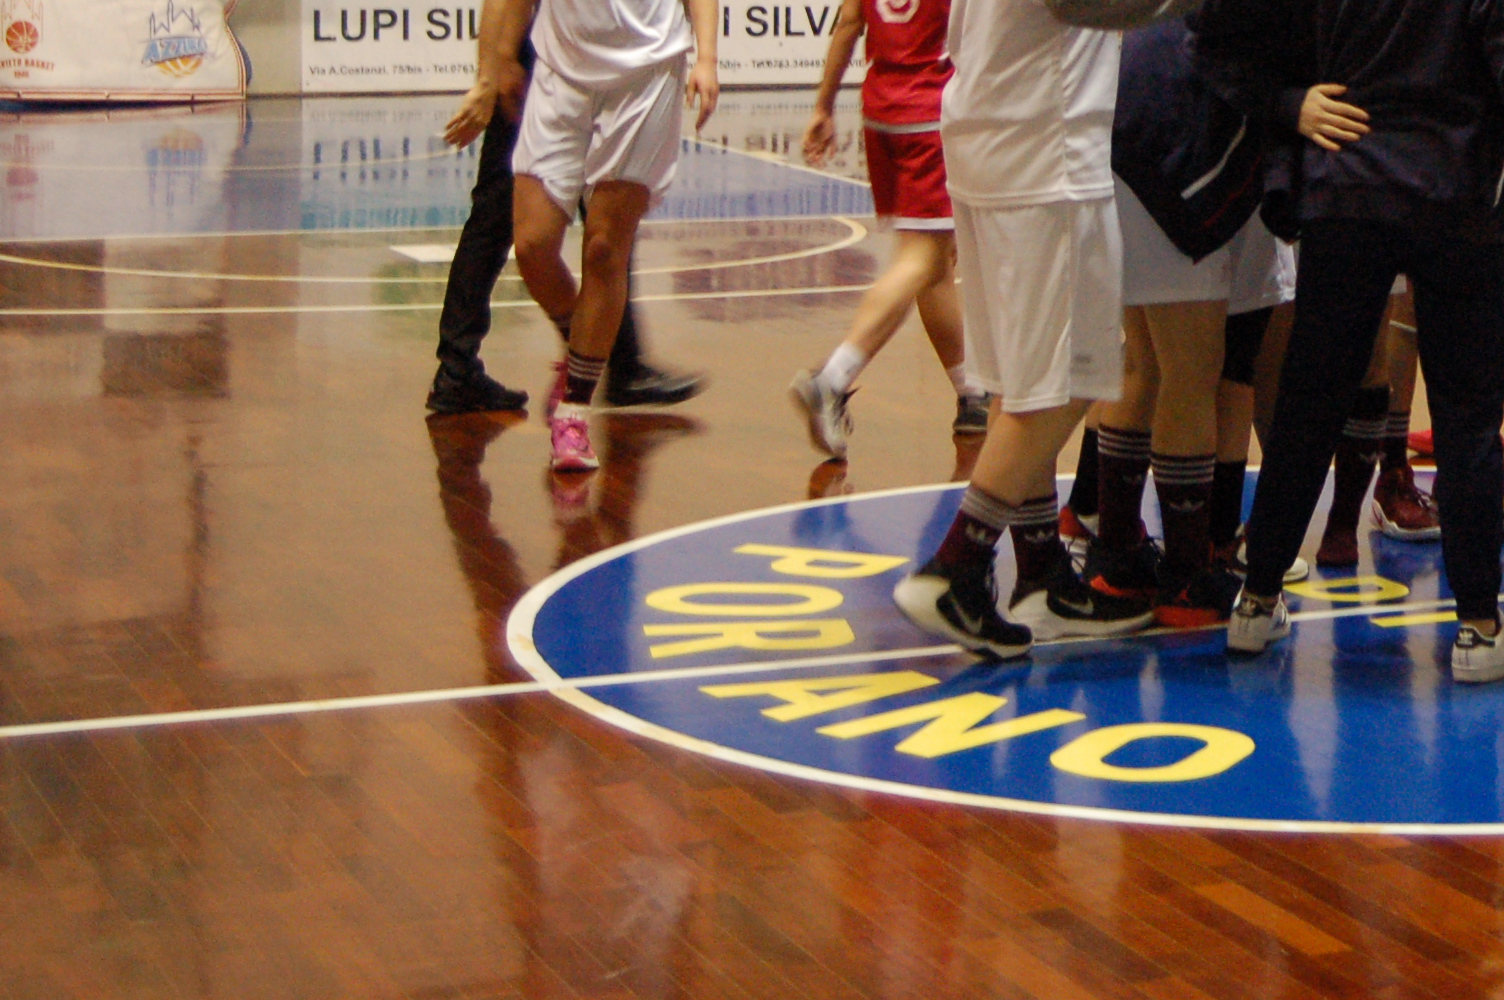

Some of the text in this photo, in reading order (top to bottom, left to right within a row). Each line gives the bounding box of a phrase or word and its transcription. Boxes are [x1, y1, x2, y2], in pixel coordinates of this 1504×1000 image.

[313, 9, 410, 42] LUPI
[309, 66, 326, 75] Via
[643, 543, 1256, 782] PORANO
